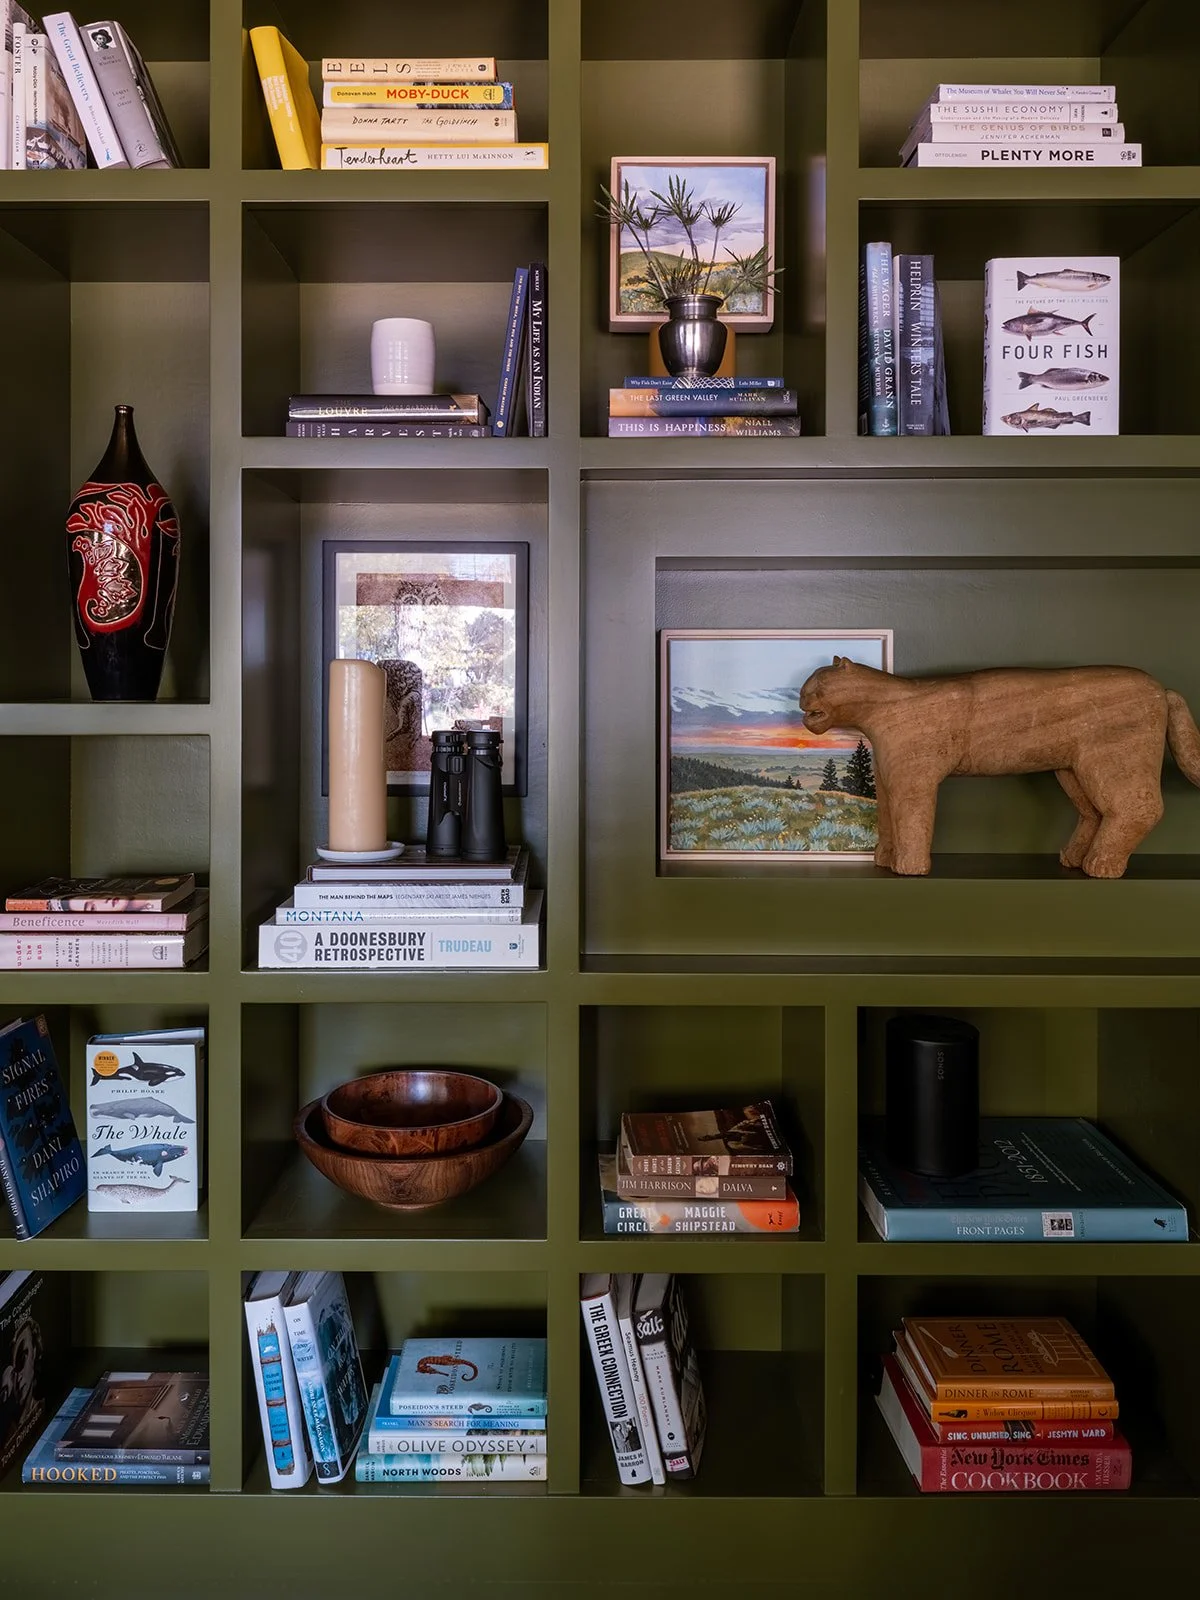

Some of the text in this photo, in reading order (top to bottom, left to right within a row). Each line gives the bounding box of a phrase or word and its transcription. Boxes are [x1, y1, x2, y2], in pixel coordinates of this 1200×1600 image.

[56, 22, 90, 101] The Great Believers
[386, 89, 469, 100] MOBY-DUCK
[983, 88, 991, 96] of
[1013, 88, 1024, 96] You
[1025, 88, 1038, 96] Will
[334, 147, 418, 169] Tenderheart
[981, 150, 1095, 161] PLENTY MORE
[880, 250, 894, 410] THE WAGER DAVID GRANN
[910, 261, 922, 405] HELPRIN WINTER'S TALE
[1002, 345, 1108, 360] FOUR FISH
[318, 406, 368, 416] LOUVRE
[618, 424, 726, 432] THIS IS HAPPINESS
[12, 917, 85, 927] Beneficence
[286, 911, 364, 921] MONTANA
[315, 932, 426, 946] A DOONESBURY
[439, 939, 492, 953] TRUDEAU
[315, 949, 425, 961] RETROSPECTIVE
[3, 1049, 46, 1085] SIGNAL
[14, 1078, 49, 1111] FIRES
[91, 1124, 188, 1140] The Whale
[33, 1136, 62, 1169] DANI
[30, 1157, 80, 1207] SHAPIRO
[622, 1179, 692, 1191] JIM HARRISON
[723, 1183, 753, 1192] DALVA
[684, 1207, 726, 1218] MAGGIE
[617, 1222, 655, 1232] CIRCLE
[675, 1221, 736, 1231] SHIPSTEAD
[956, 1227, 1025, 1235] FRONT PAGES
[977, 1323, 1023, 1374] ROME
[588, 1303, 628, 1419] THE GREEK CONNECTION
[625, 1332, 635, 1358] Seamus
[631, 1357, 640, 1383] Heaney
[641, 1406, 650, 1427] Poems
[945, 1389, 988, 1398] DINNER
[1003, 1389, 1034, 1398] ROME
[983, 1408, 1006, 1417] Widow
[482, 1420, 519, 1428] MEANING
[948, 1432, 1032, 1441] SING, UNBURIED, SING
[1047, 1430, 1106, 1439] JESMYN WARD
[398, 1440, 526, 1452] OLIVE ODYSSEY
[620, 1460, 644, 1468] BARRON
[951, 1448, 1090, 1470] New York Times
[32, 1468, 117, 1481] HOOKED
[382, 1468, 462, 1476] NORTH WOODS
[1103, 1456, 1111, 1485] HESSER
[951, 1472, 1089, 1490] COOKBOOK
